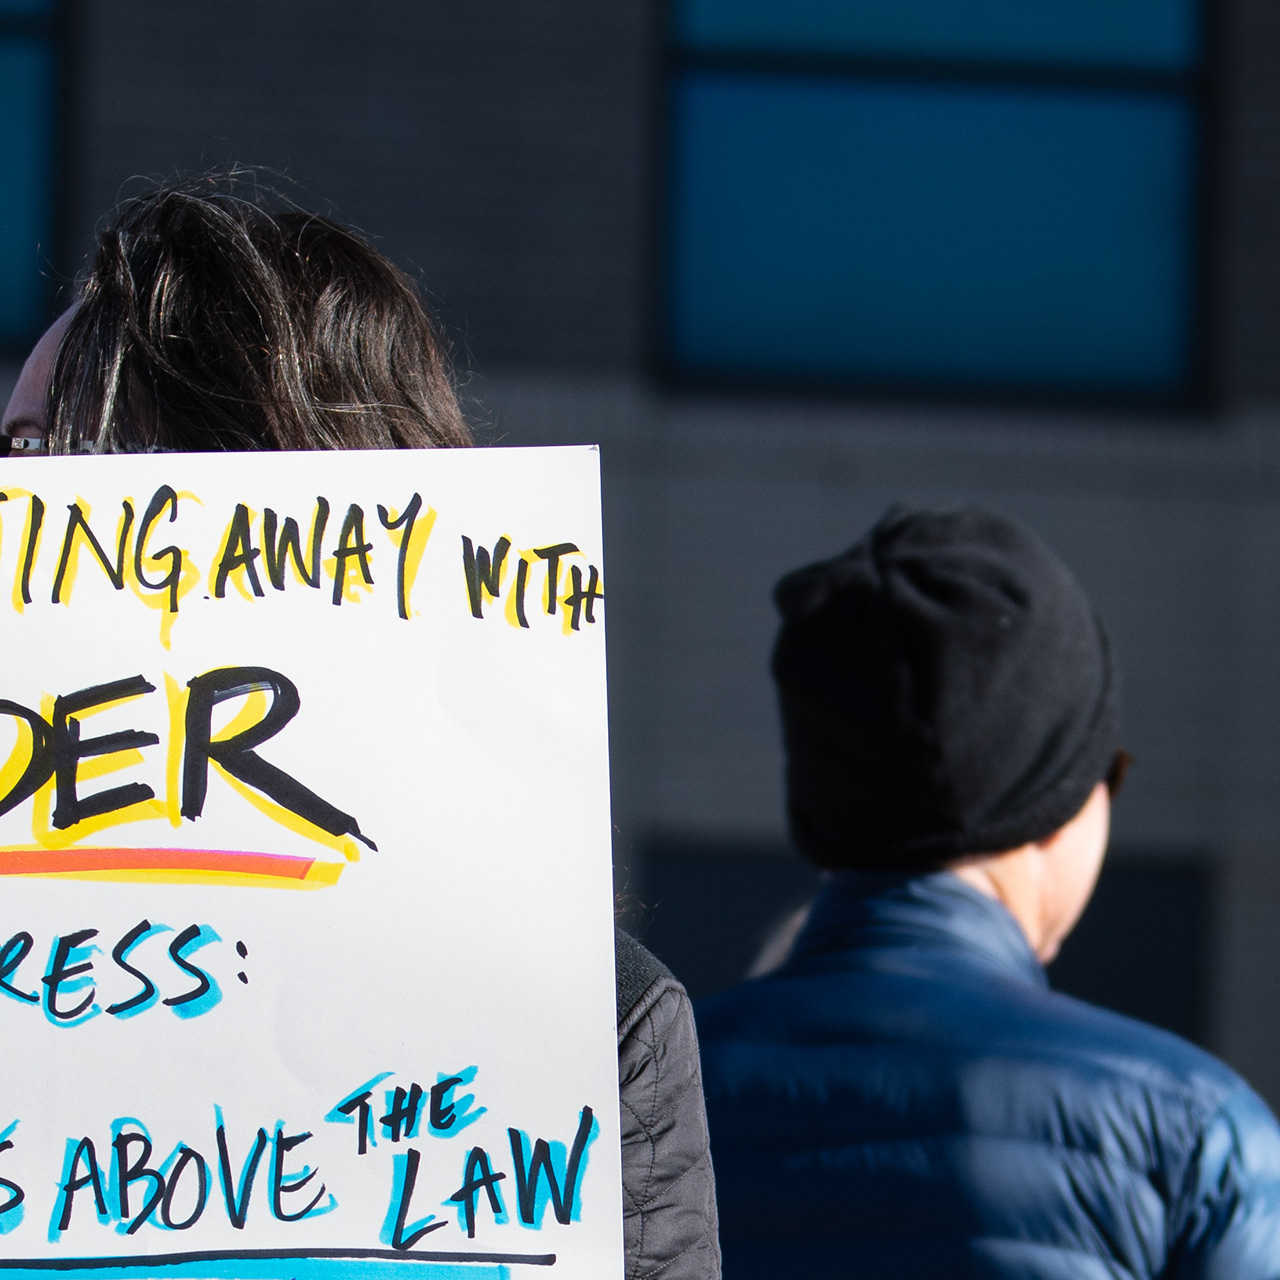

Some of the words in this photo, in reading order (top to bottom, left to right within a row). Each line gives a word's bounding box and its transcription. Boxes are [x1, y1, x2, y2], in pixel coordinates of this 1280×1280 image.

[208, 491, 438, 621] AWAY
[460, 532, 604, 635] WITH
[46, 1103, 339, 1243] ABOVE
[324, 1064, 488, 1155] THE
[380, 1104, 601, 1250] LAW
